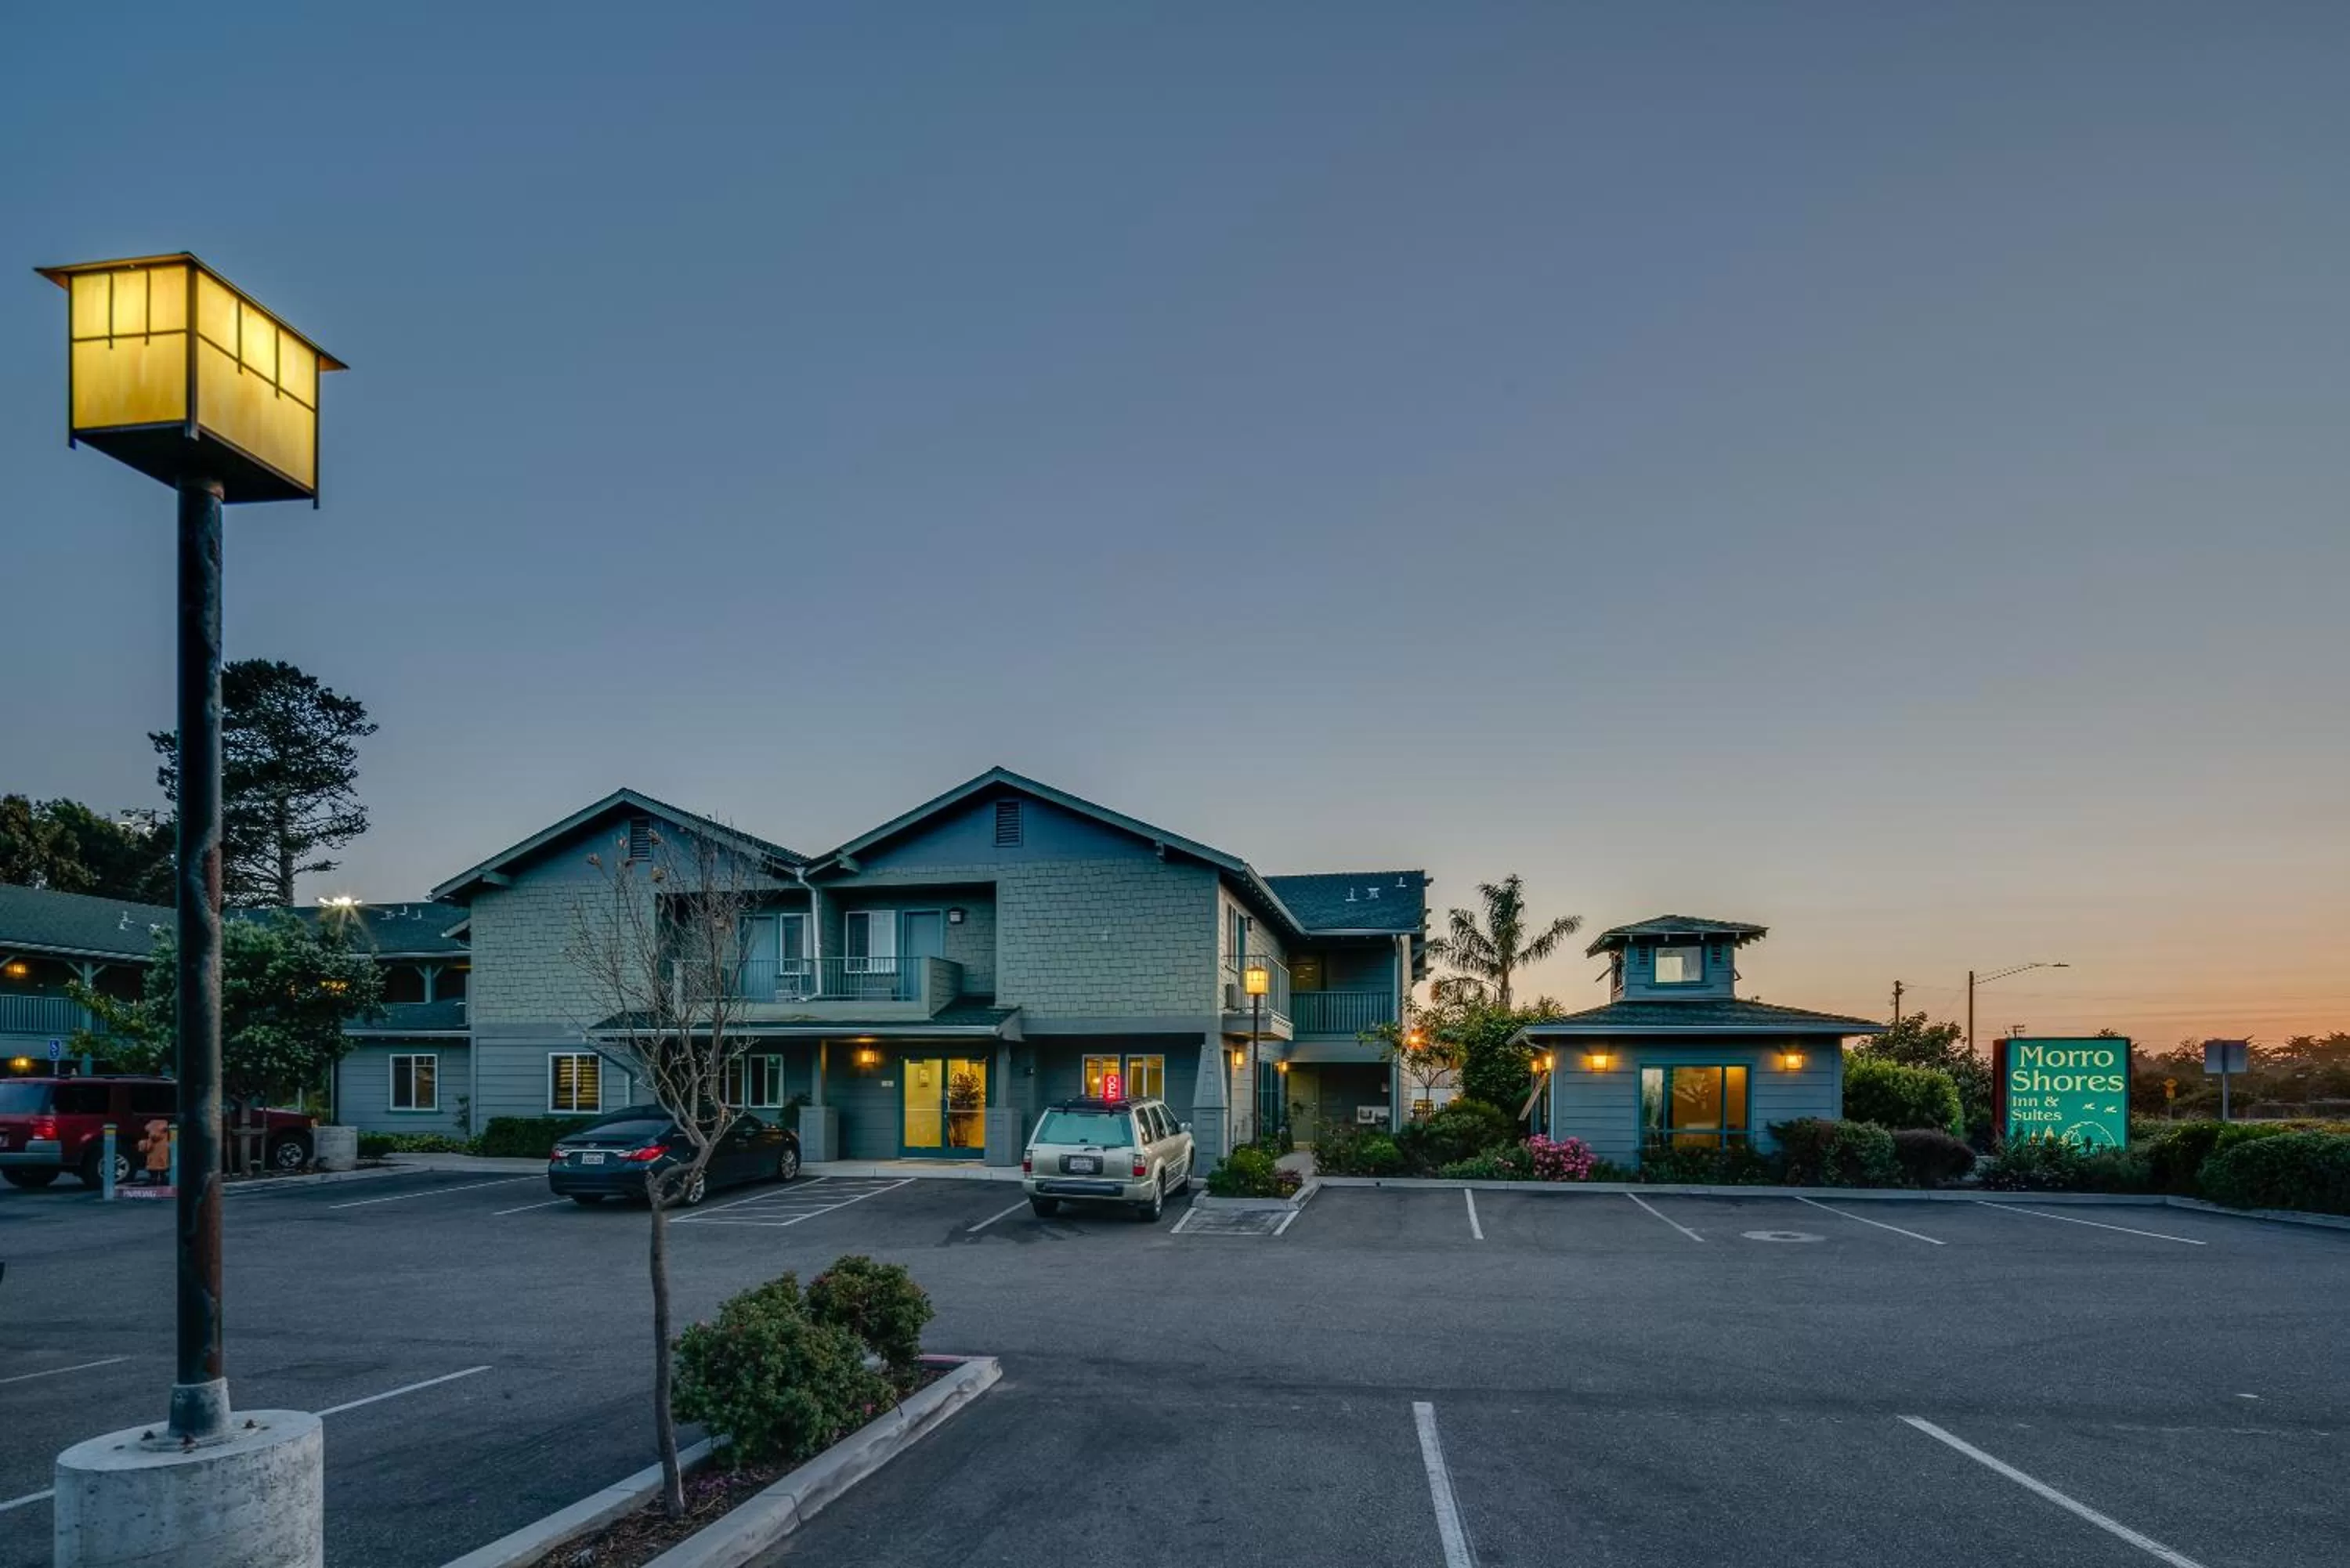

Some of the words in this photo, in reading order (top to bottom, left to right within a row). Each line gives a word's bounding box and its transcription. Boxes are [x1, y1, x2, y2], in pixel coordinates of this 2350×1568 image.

[2019, 1046, 2114, 1068] Morro
[2011, 1069, 2125, 1092] Shores
[2012, 1096, 2038, 1107] Inn
[2044, 1096, 2059, 1107] &
[2011, 1109, 2063, 1121] Suites
